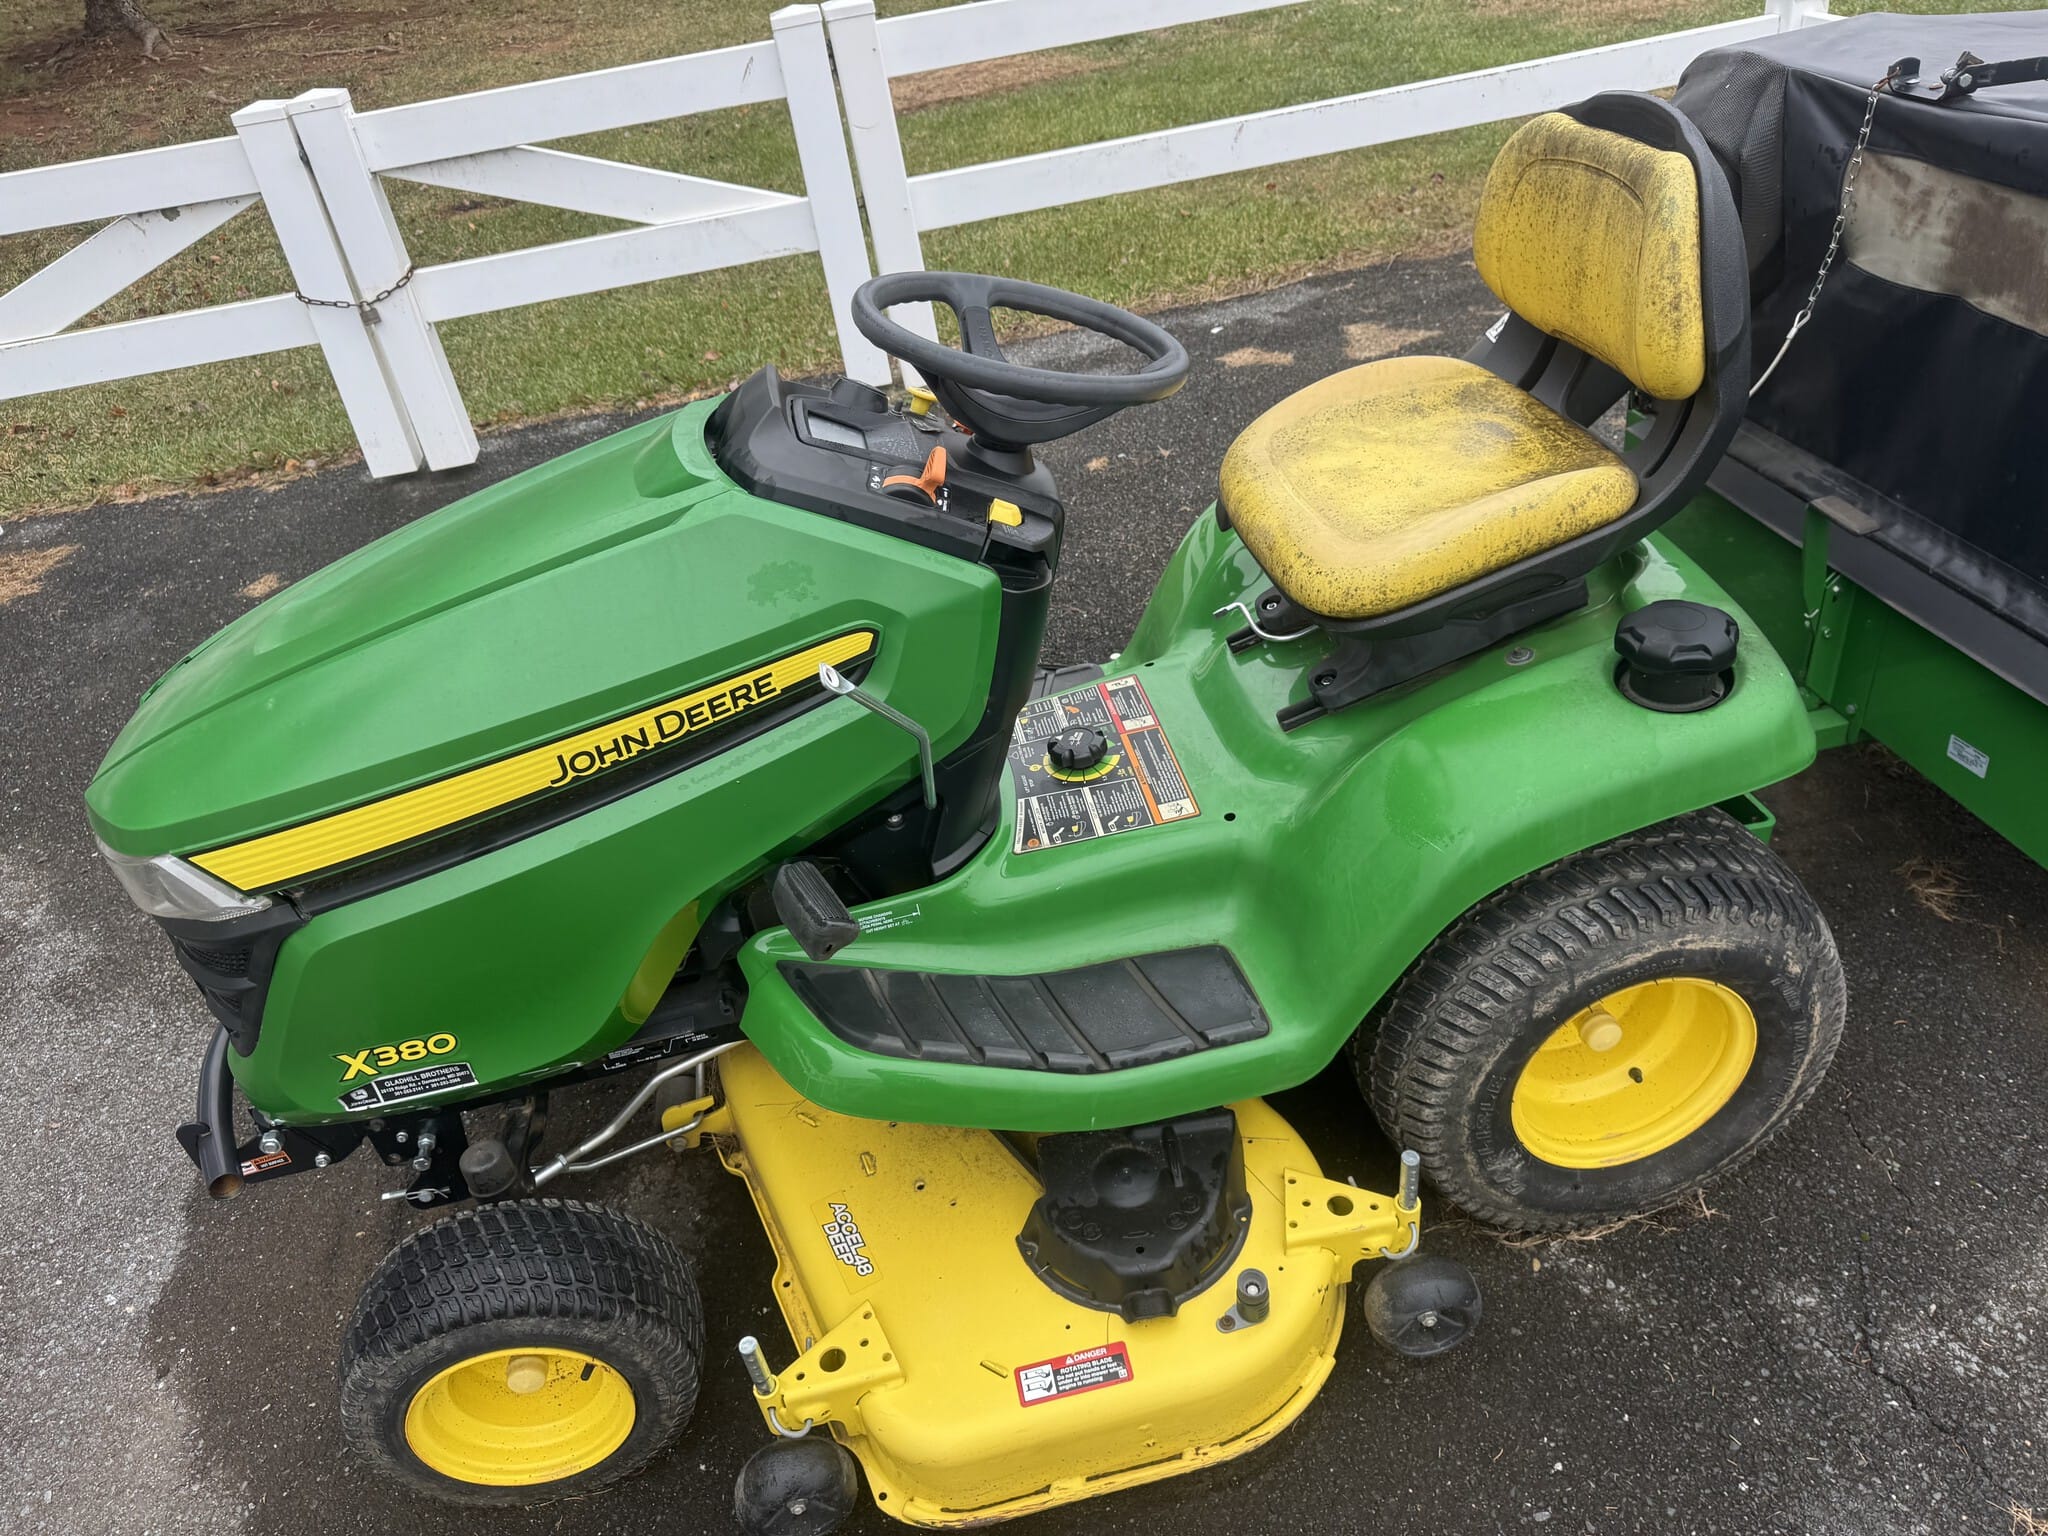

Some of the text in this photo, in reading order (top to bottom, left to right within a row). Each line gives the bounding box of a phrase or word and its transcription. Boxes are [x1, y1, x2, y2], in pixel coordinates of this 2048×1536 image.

[550, 672, 778, 786] JOHN DEERE
[336, 1032, 457, 1081] X380
[384, 1066, 460, 1087] GLADHILL BROTHERS
[822, 1221, 857, 1266] DEEP
[1060, 1356, 1113, 1375] ROTATING BLADE
[1074, 1347, 1107, 1361] DANGER
